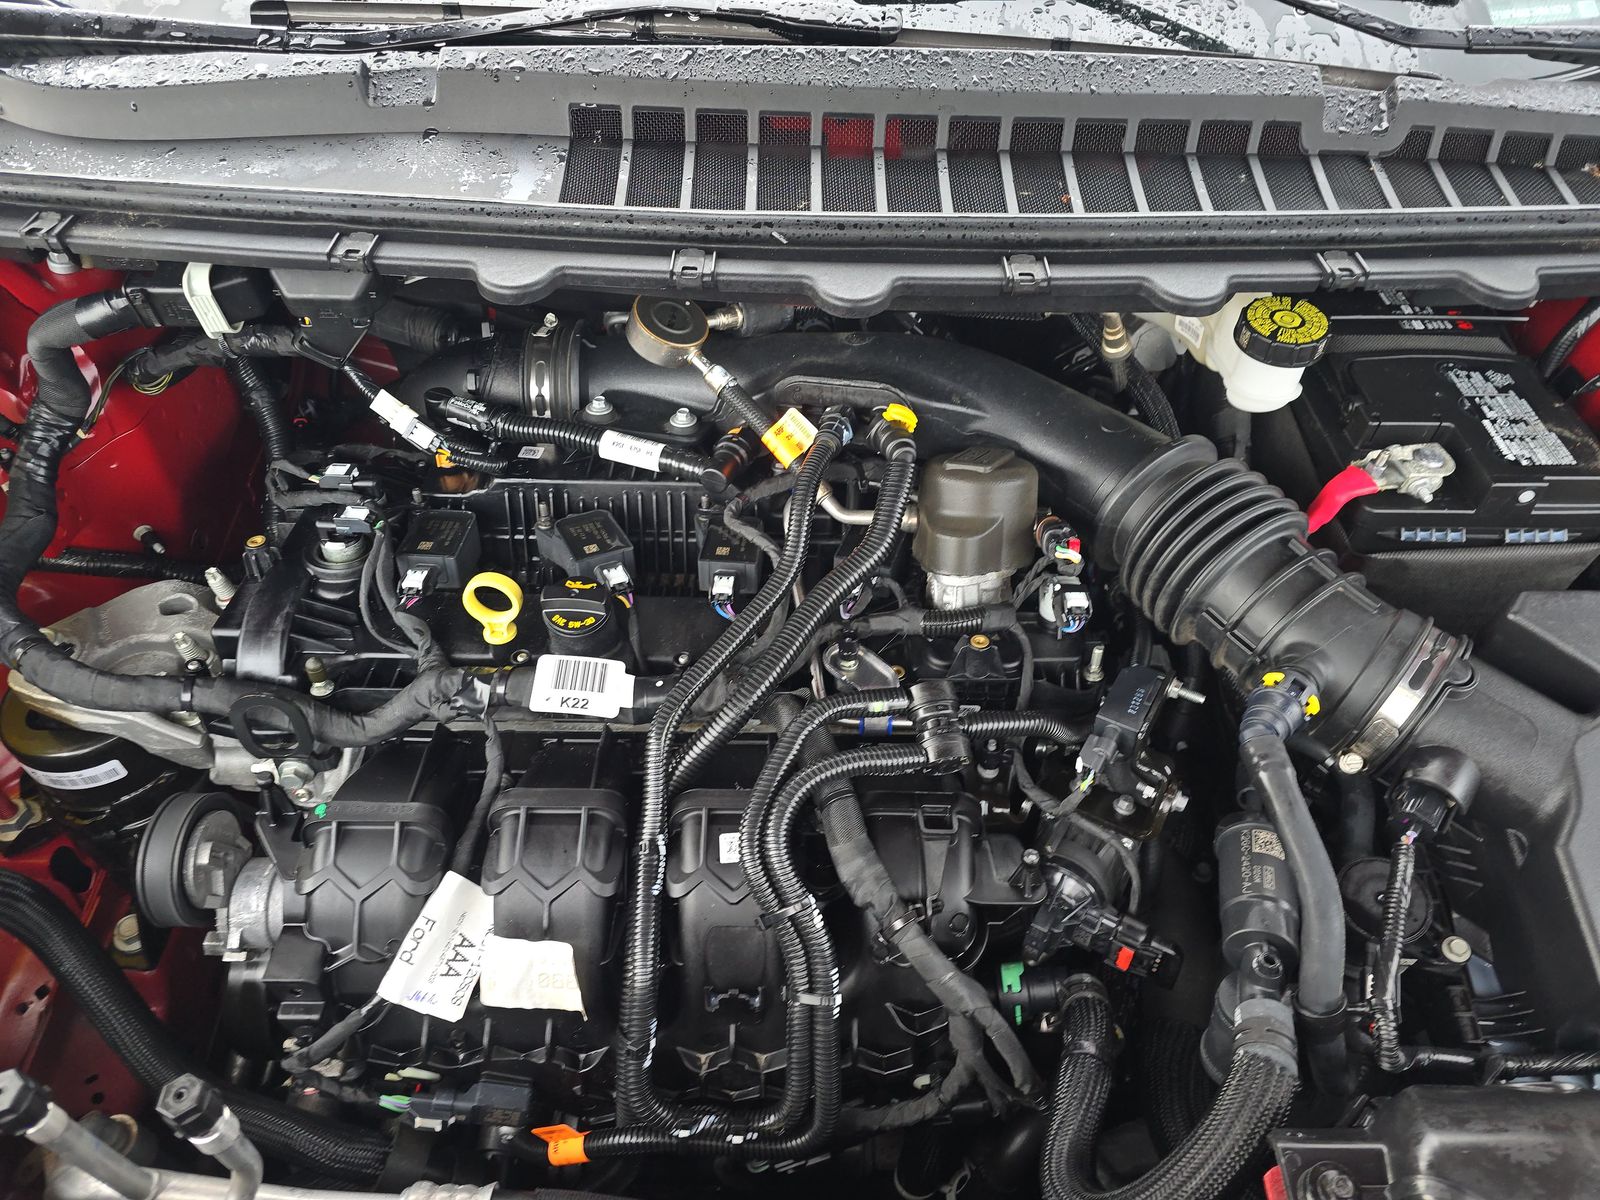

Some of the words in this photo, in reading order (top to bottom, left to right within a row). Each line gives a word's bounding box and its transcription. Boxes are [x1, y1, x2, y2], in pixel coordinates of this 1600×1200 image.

[560, 696, 589, 710] K22
[399, 915, 437, 965] Ford
[439, 932, 477, 977] AAA
